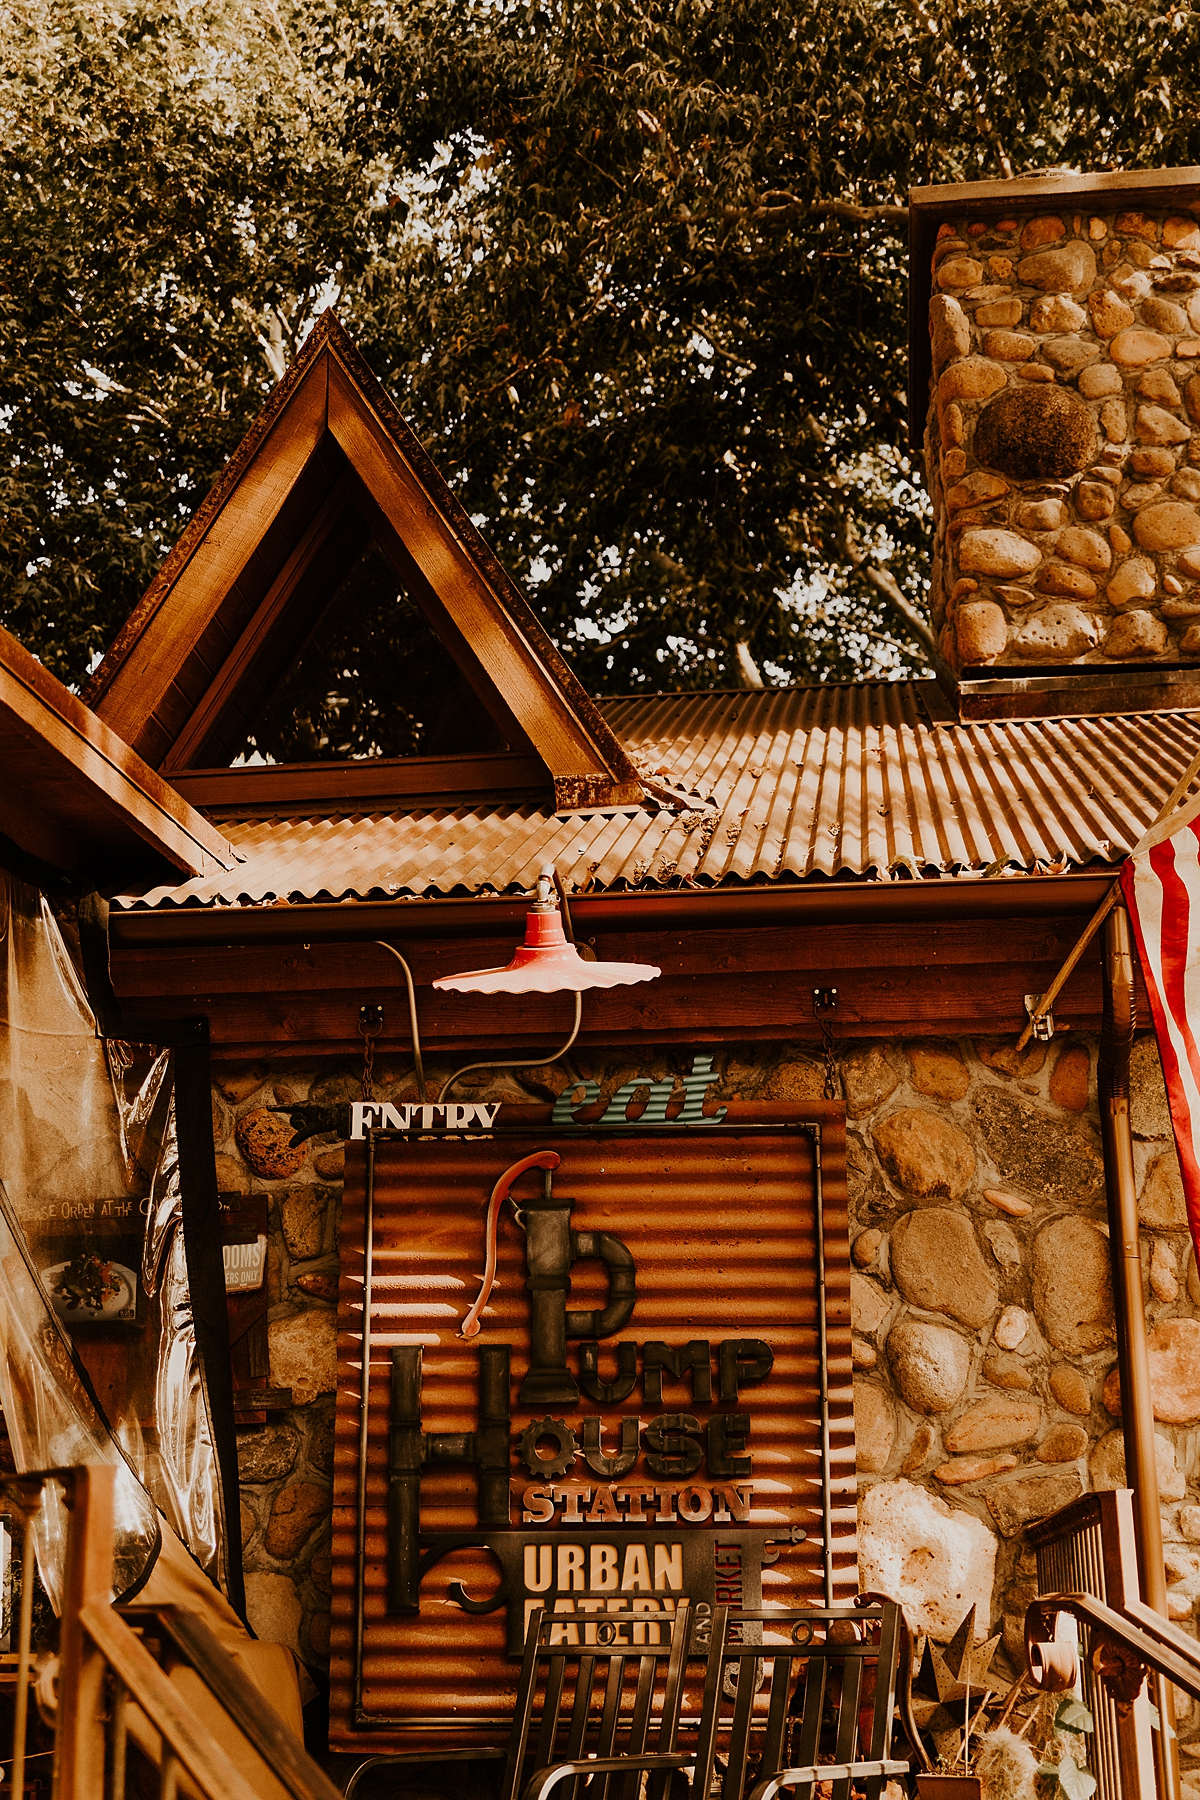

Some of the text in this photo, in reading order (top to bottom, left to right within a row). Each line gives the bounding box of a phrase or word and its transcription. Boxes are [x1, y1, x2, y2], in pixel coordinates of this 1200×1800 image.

[552, 1054, 728, 1134] eat
[350, 1102, 502, 1140] ENTRY
[61, 1201, 95, 1219] ORDER
[241, 1270, 259, 1283] ONLY
[520, 1198, 775, 1402] PUMP
[389, 1343, 753, 1614] HOUSE
[522, 1484, 754, 1523] STATION
[523, 1543, 683, 1591] URBAN
[714, 1539, 744, 1645] MRKET
[695, 1602, 713, 1646] AND
